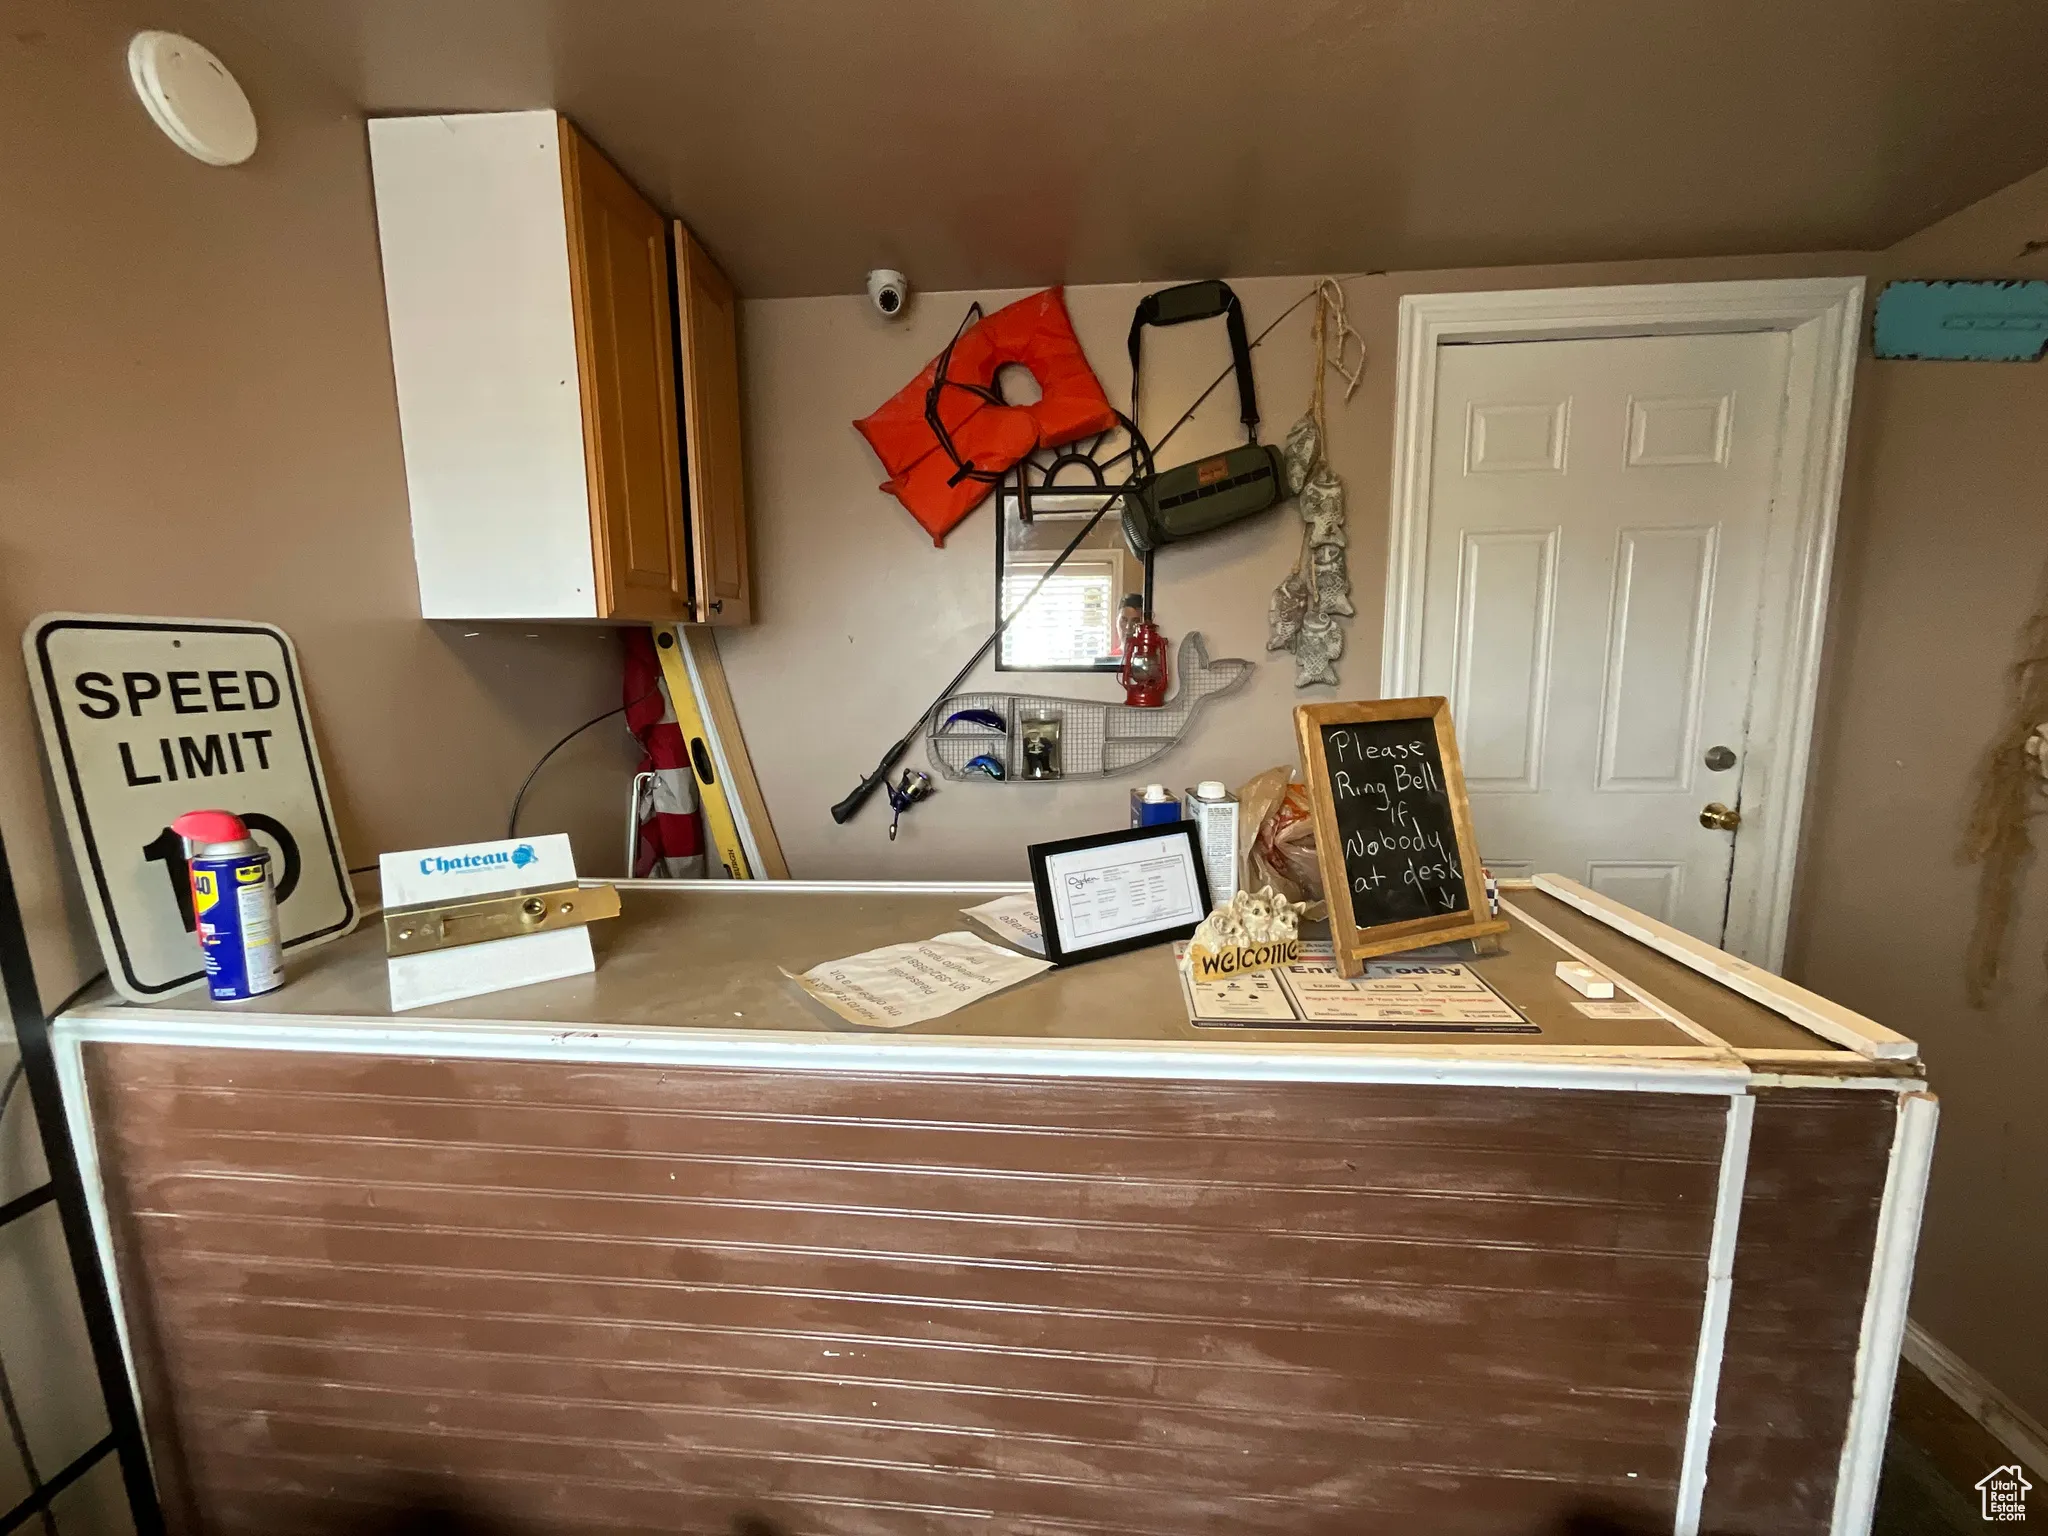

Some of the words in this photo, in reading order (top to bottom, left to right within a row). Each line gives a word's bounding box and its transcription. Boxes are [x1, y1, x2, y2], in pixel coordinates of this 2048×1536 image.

[75, 669, 280, 720] SPEED
[118, 729, 272, 787] LIMIT
[1329, 730, 1426, 762] Please
[1335, 771, 1391, 810] Ring
[1394, 762, 1438, 793] Bell
[1346, 817, 1449, 862] Nobody
[420, 852, 509, 875] Chateau
[1068, 873, 1100, 889] Ogden
[1354, 865, 1387, 893] at
[1403, 852, 1463, 905] desk
[905, 974, 936, 995] Please
[1376, 965, 1461, 976] Today
